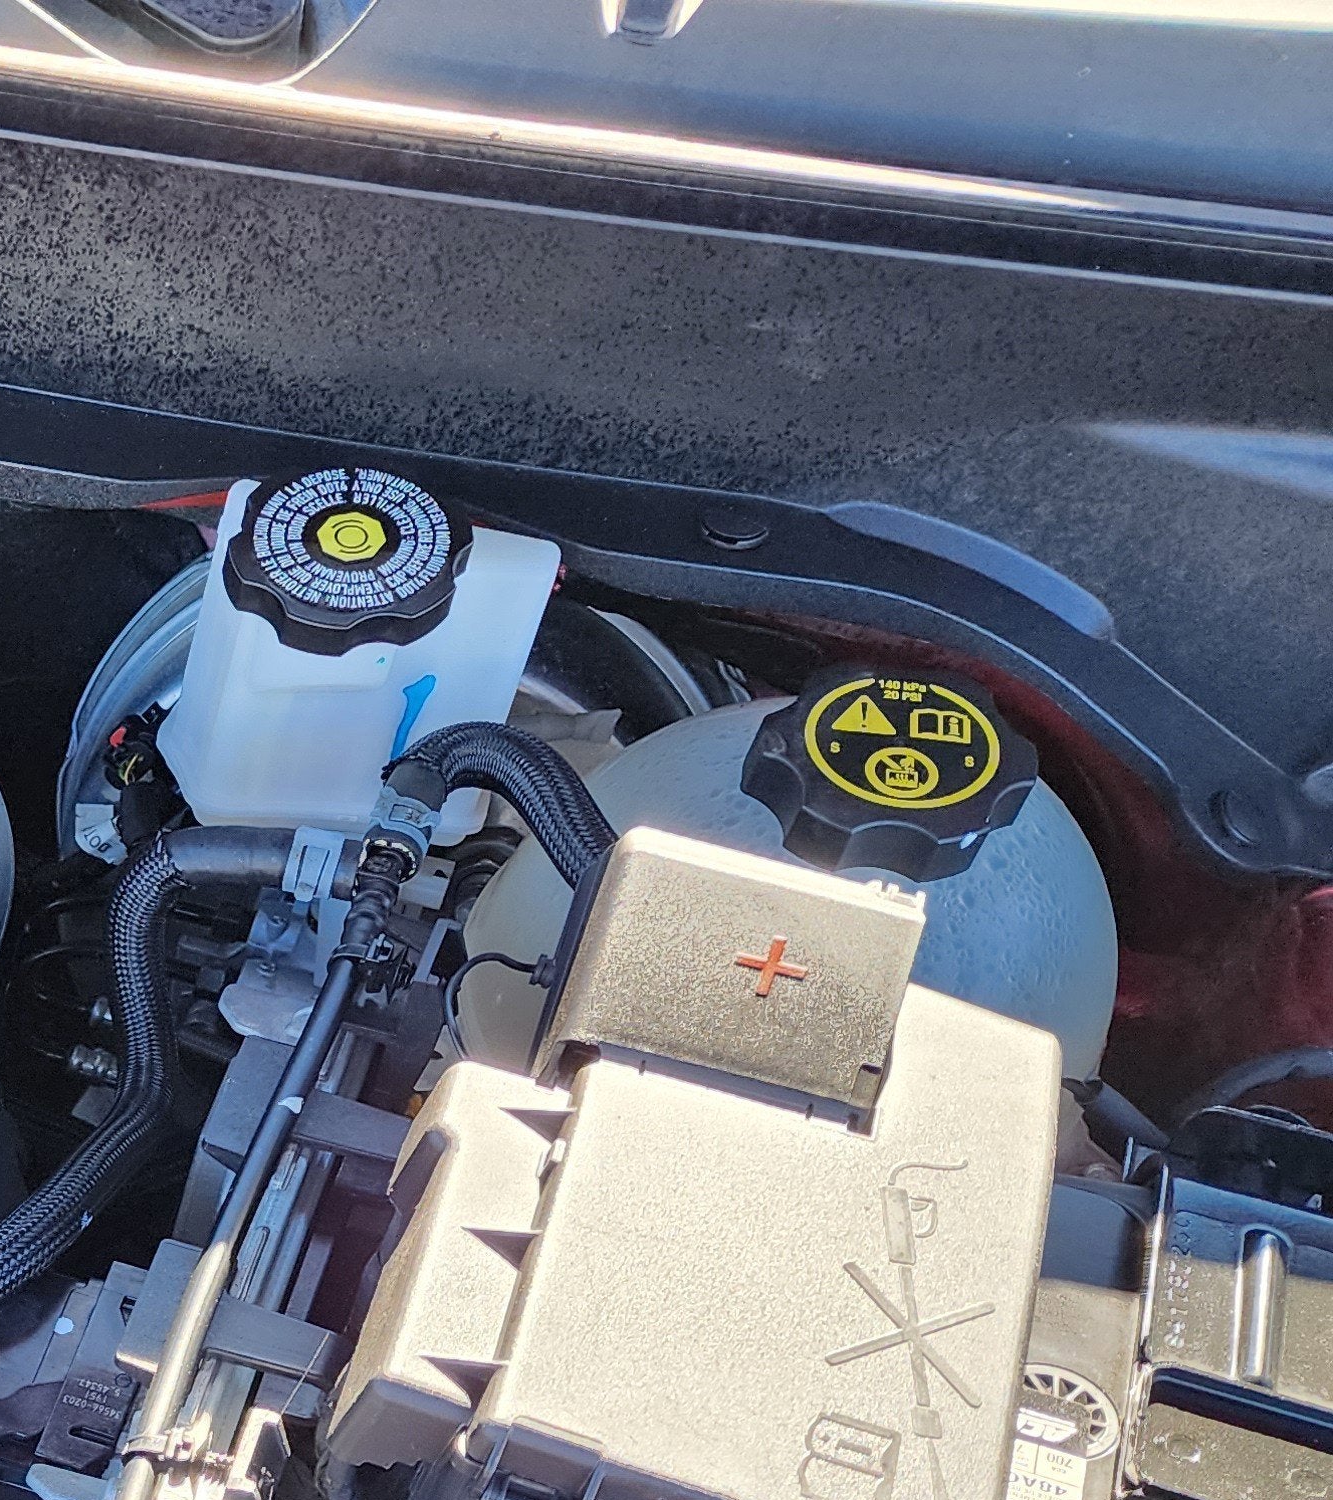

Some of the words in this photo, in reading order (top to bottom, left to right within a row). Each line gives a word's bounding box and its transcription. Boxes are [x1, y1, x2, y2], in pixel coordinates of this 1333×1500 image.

[284, 481, 301, 495] LA
[289, 486, 319, 508] FREIN
[318, 481, 348, 494] DOT4
[353, 480, 385, 495] ONLY
[384, 486, 406, 503] USE
[261, 490, 289, 517] AVANT
[353, 492, 395, 513] FILLER
[417, 492, 448, 524] SEALED
[275, 507, 292, 521] DE
[386, 506, 416, 535] CLEAN
[289, 512, 307, 540] BIDON
[436, 522, 450, 531] A
[253, 516, 271, 558] BOUCHON
[270, 522, 287, 554] LIQUIDE
[435, 530, 451, 555] FROM
[259, 559, 277, 571] LE
[275, 553, 294, 568] DU
[403, 542, 433, 576] BEFORE
[418, 554, 447, 583] FLUID
[286, 564, 313, 584] QUE
[307, 559, 376, 584] PROVENANT
[386, 569, 411, 589] CAP
[268, 570, 320, 604] NETTOYER
[398, 576, 427, 599] DOT4
[878, 679, 900, 691] 140
[902, 681, 928, 693] kPa
[883, 689, 900, 700] 20
[902, 690, 922, 702] PSI
[85, 1389, 108, 1404] 1951
[1047, 1452, 1074, 1470] 700
